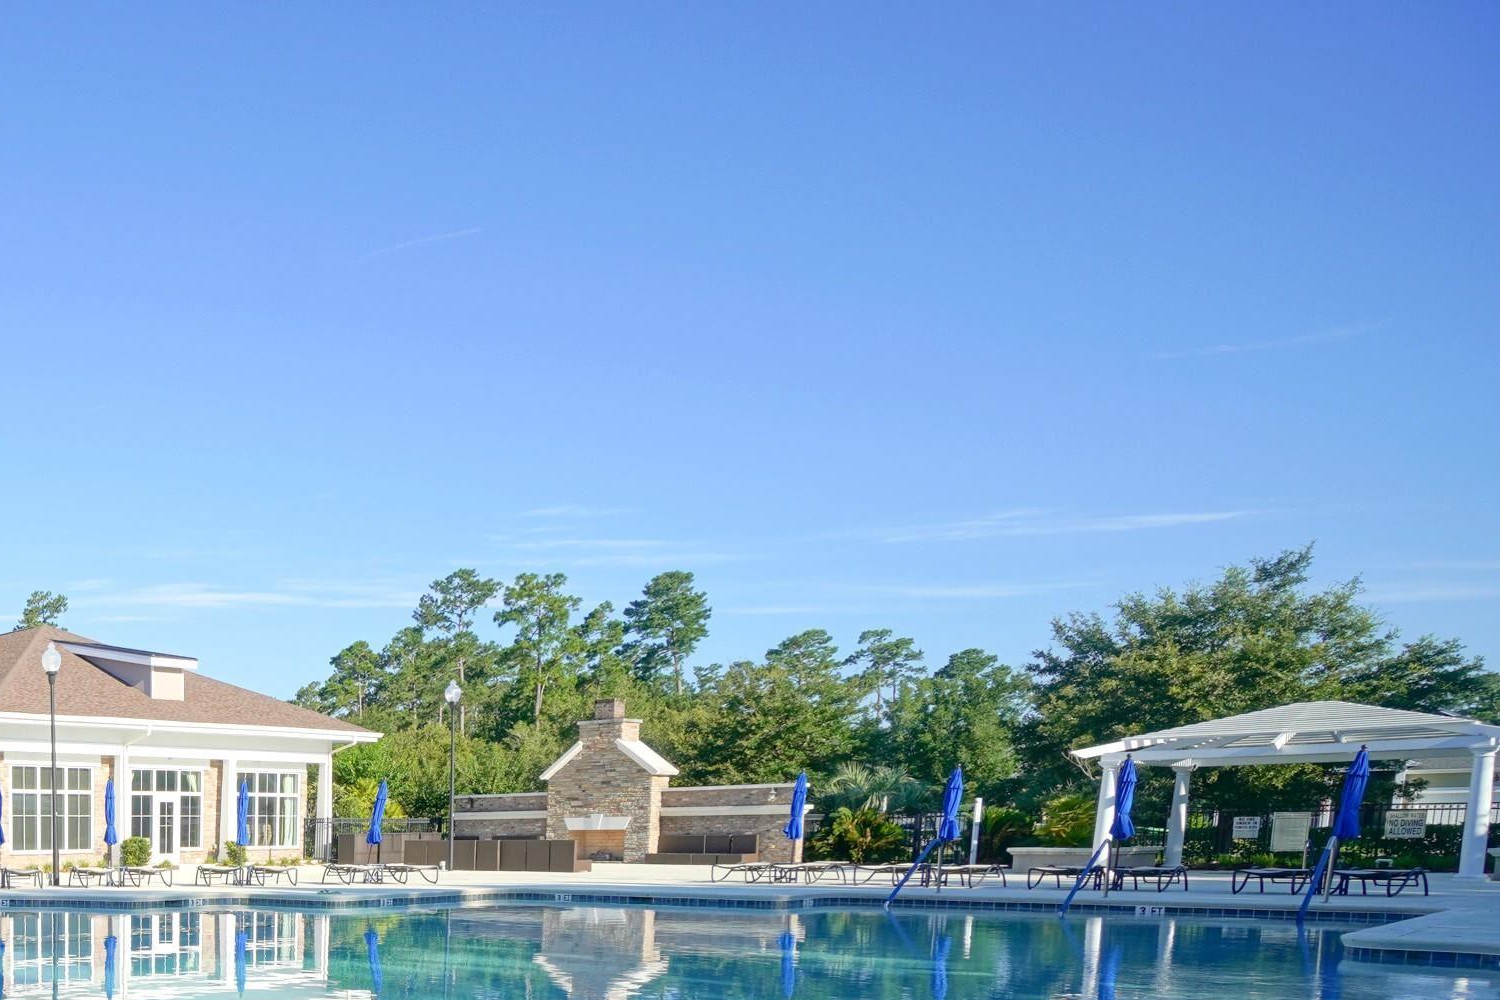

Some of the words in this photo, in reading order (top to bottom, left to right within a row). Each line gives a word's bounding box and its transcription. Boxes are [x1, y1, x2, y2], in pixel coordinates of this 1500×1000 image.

[1389, 819, 1399, 827] NO
[1400, 819, 1424, 827] DIVING
[1388, 827, 1422, 835] ALLOWED
